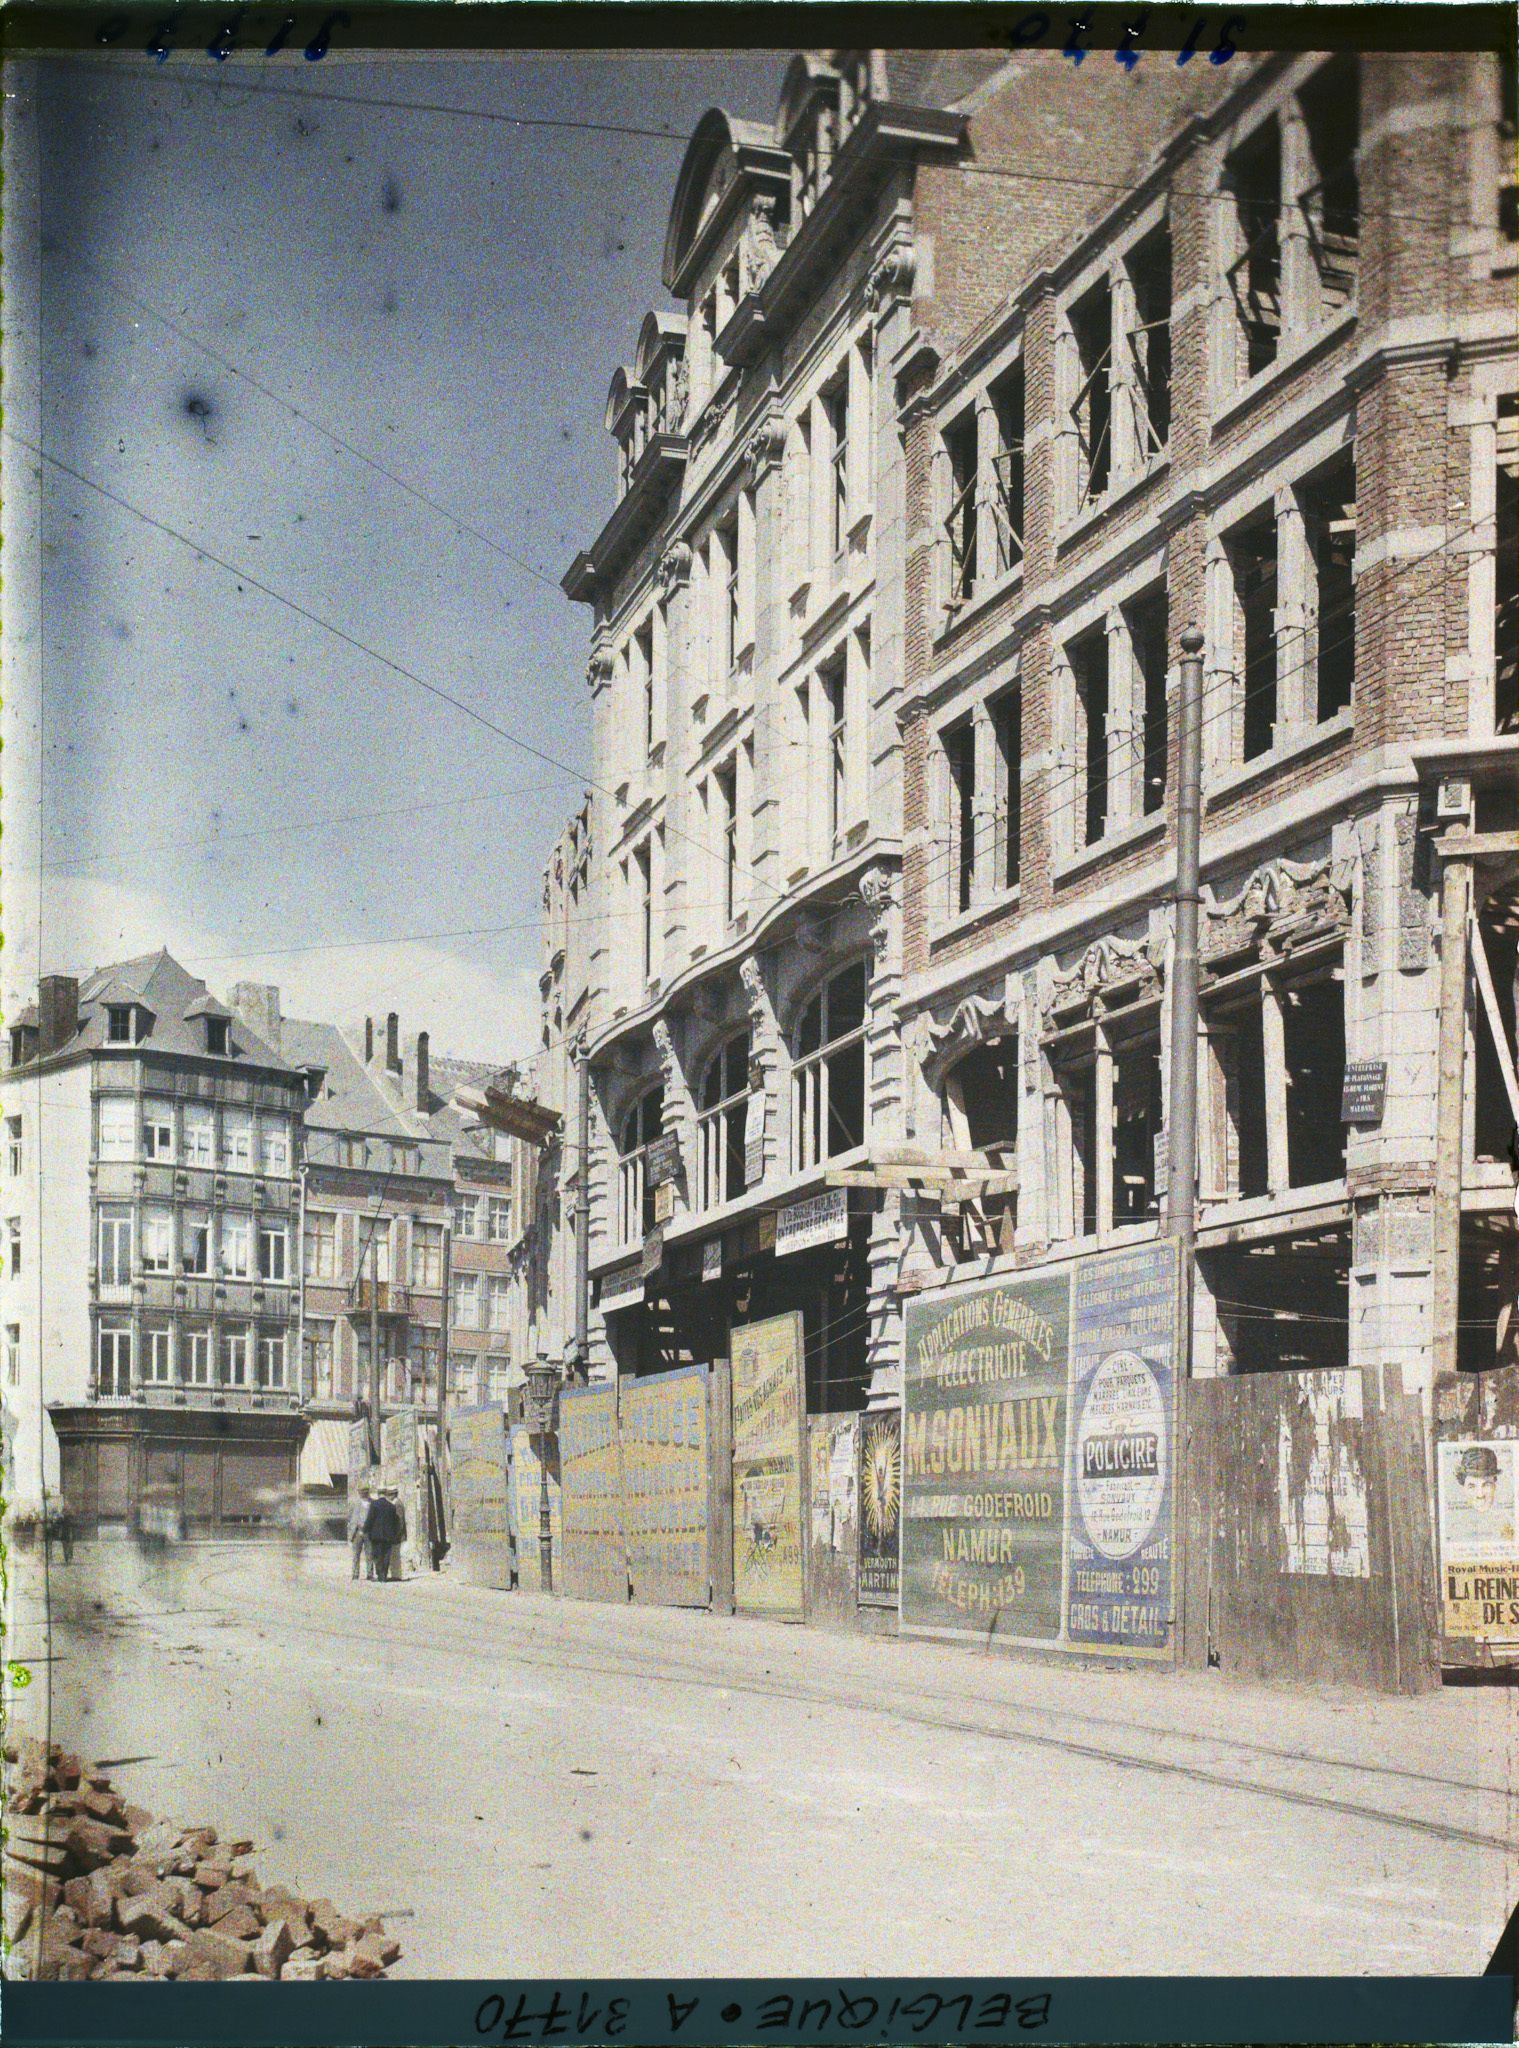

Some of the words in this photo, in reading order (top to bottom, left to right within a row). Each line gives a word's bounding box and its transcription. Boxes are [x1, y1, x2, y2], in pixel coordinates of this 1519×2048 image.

[1086, 1436, 1156, 1472] POLICIRE
[963, 1492, 1053, 1518] GODEFROID
[942, 1528, 1014, 1564] NAMUR
[1447, 1564, 1477, 1575] Royal
[1070, 1603, 1099, 1631] GROS
[1483, 1603, 1505, 1625] DE
